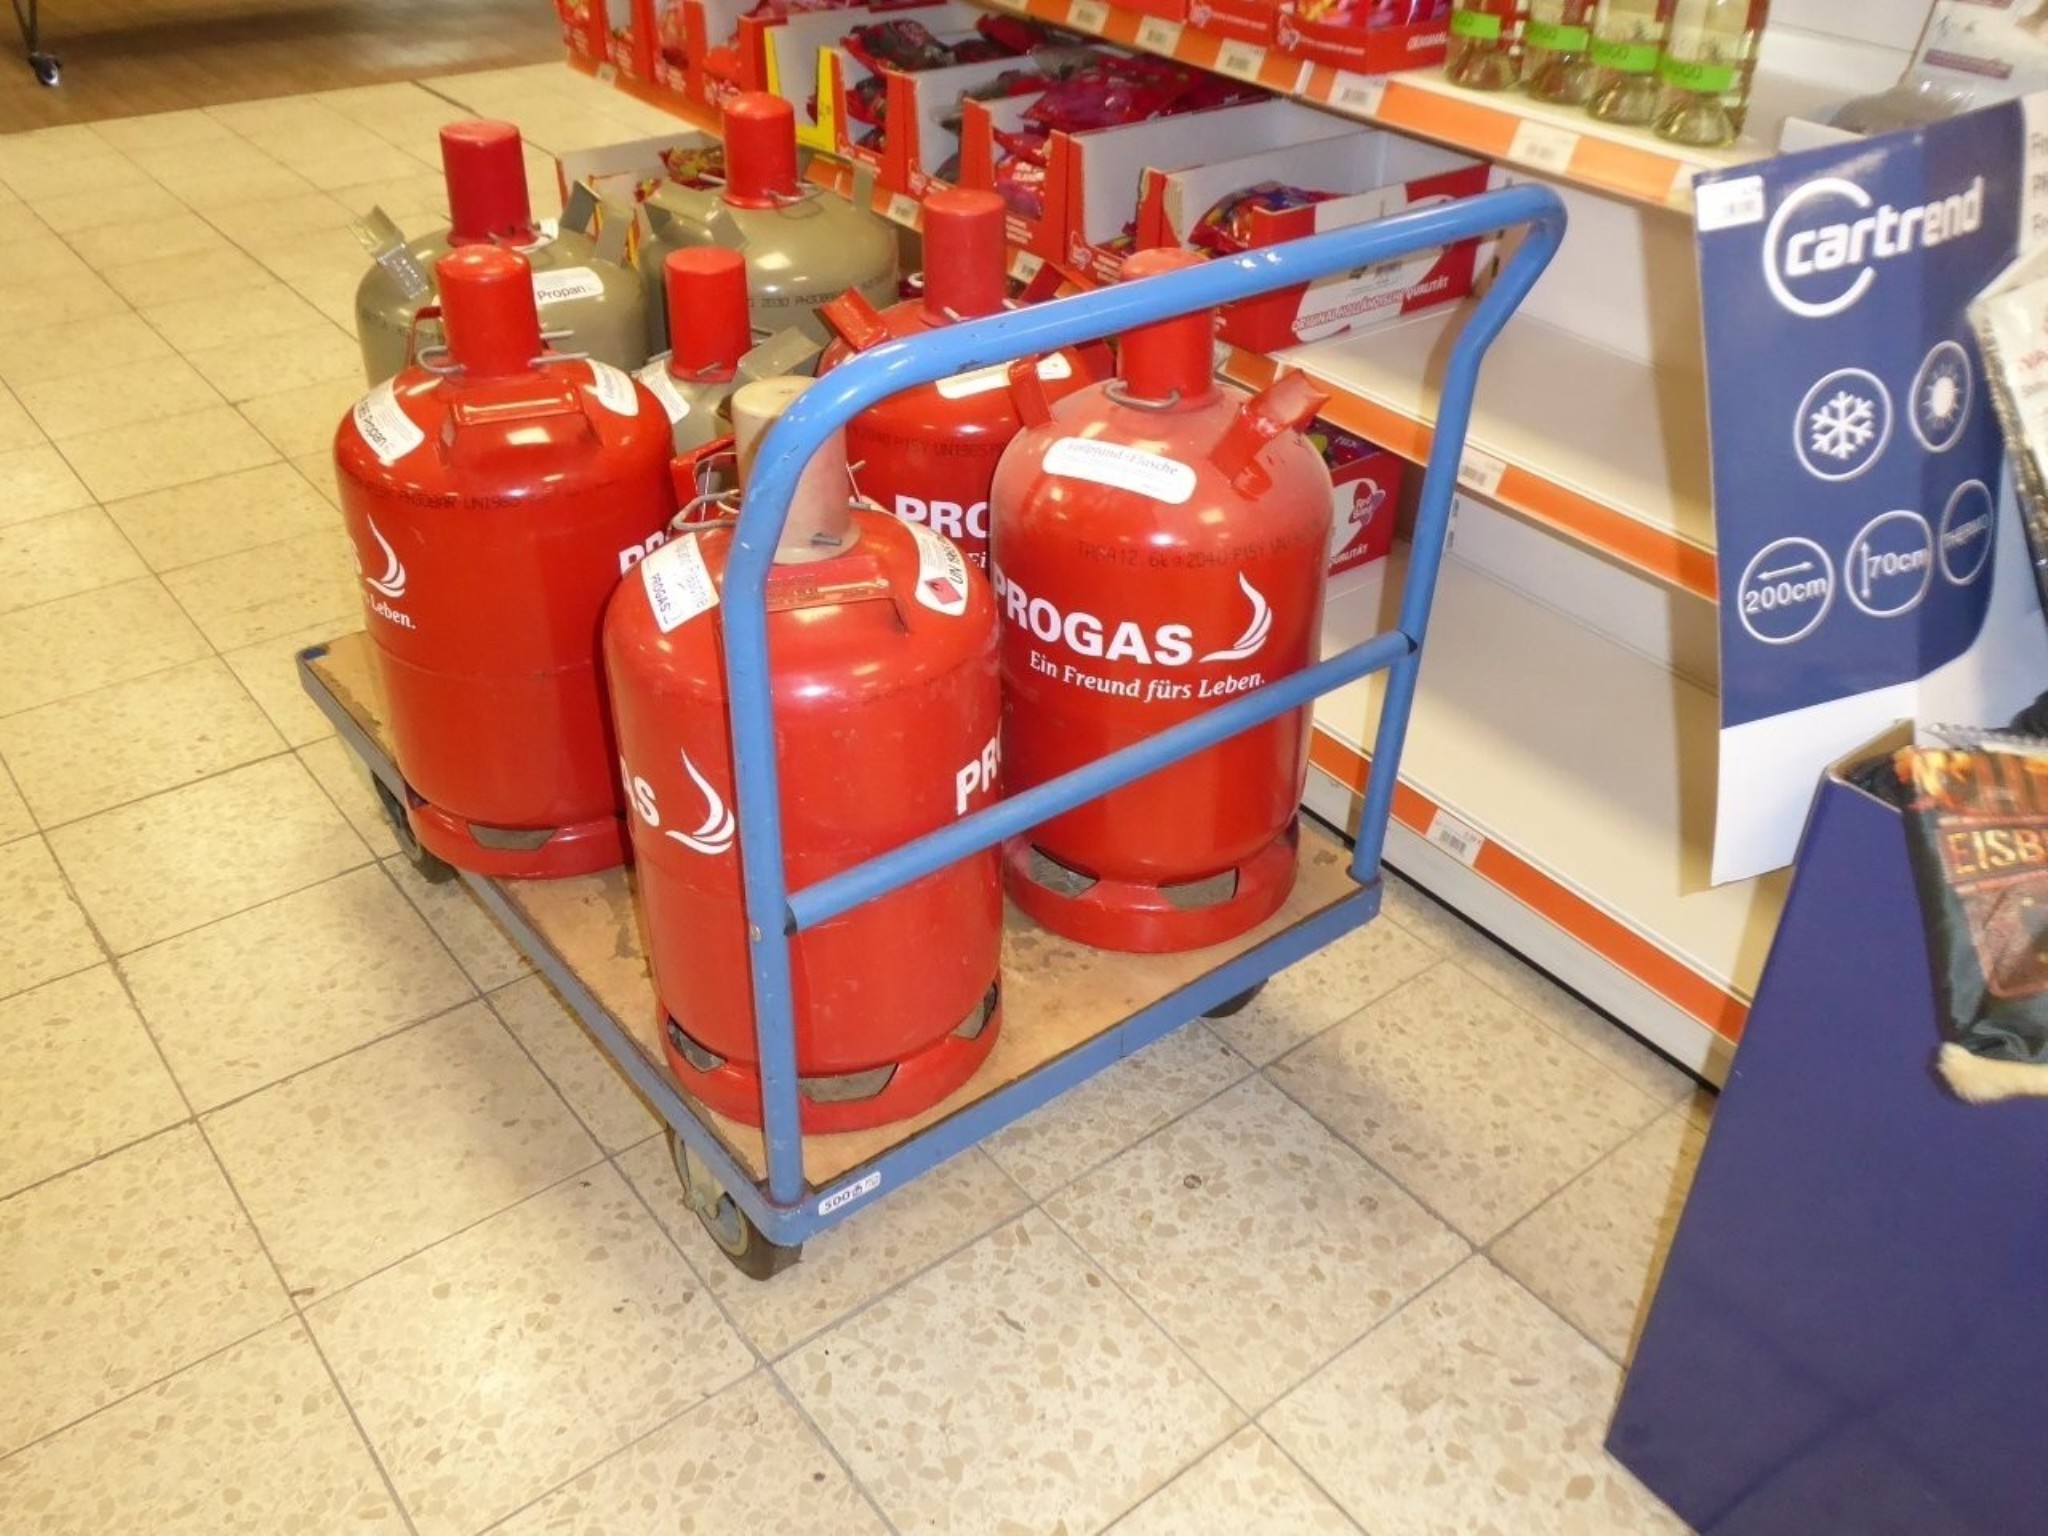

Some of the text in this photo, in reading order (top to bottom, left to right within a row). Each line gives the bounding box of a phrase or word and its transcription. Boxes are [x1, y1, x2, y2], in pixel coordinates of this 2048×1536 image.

[1785, 174, 1984, 277] cartrend
[536, 285, 587, 301] Propan
[1867, 547, 1931, 579] 70cm
[370, 593, 417, 630] Leben.
[1744, 576, 1828, 614] 200cm
[993, 570, 1193, 667] PROGAS
[1029, 650, 1266, 703] Ein Freund fürs Leben.
[956, 715, 1002, 816] PR
[823, 1190, 851, 1211] 500
